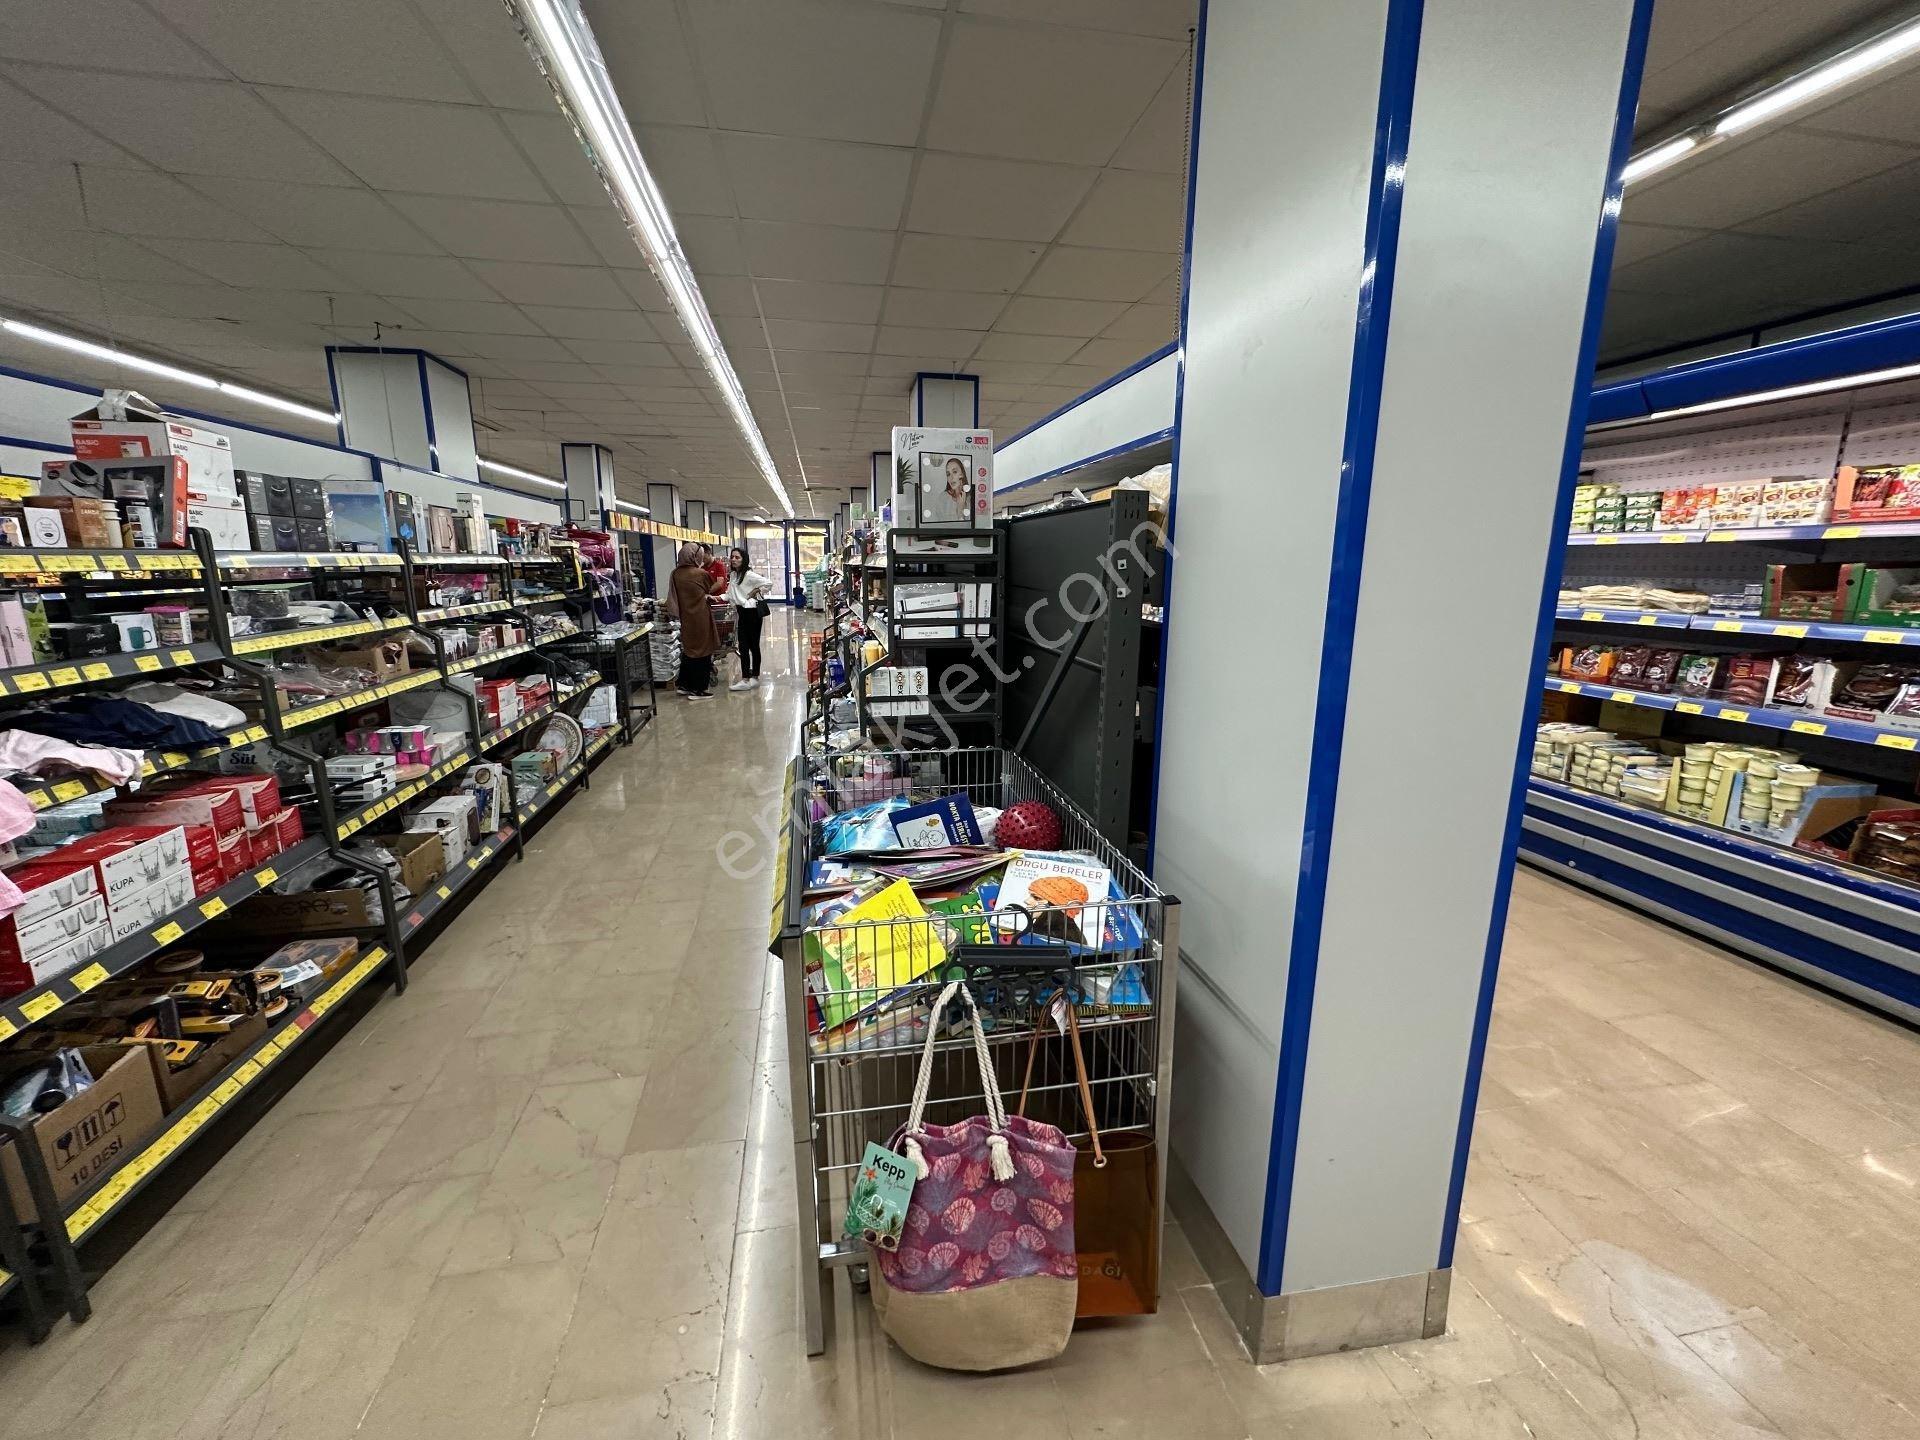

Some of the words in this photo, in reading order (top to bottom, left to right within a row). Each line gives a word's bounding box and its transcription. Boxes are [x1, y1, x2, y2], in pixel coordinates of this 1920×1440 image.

[230, 752, 258, 765] Süt
[1052, 864, 1104, 880] BERELER
[109, 876, 135, 893] KUPA
[116, 919, 142, 937] KUPA
[71, 1165, 89, 1186] 10
[872, 1154, 906, 1180] Kepp
